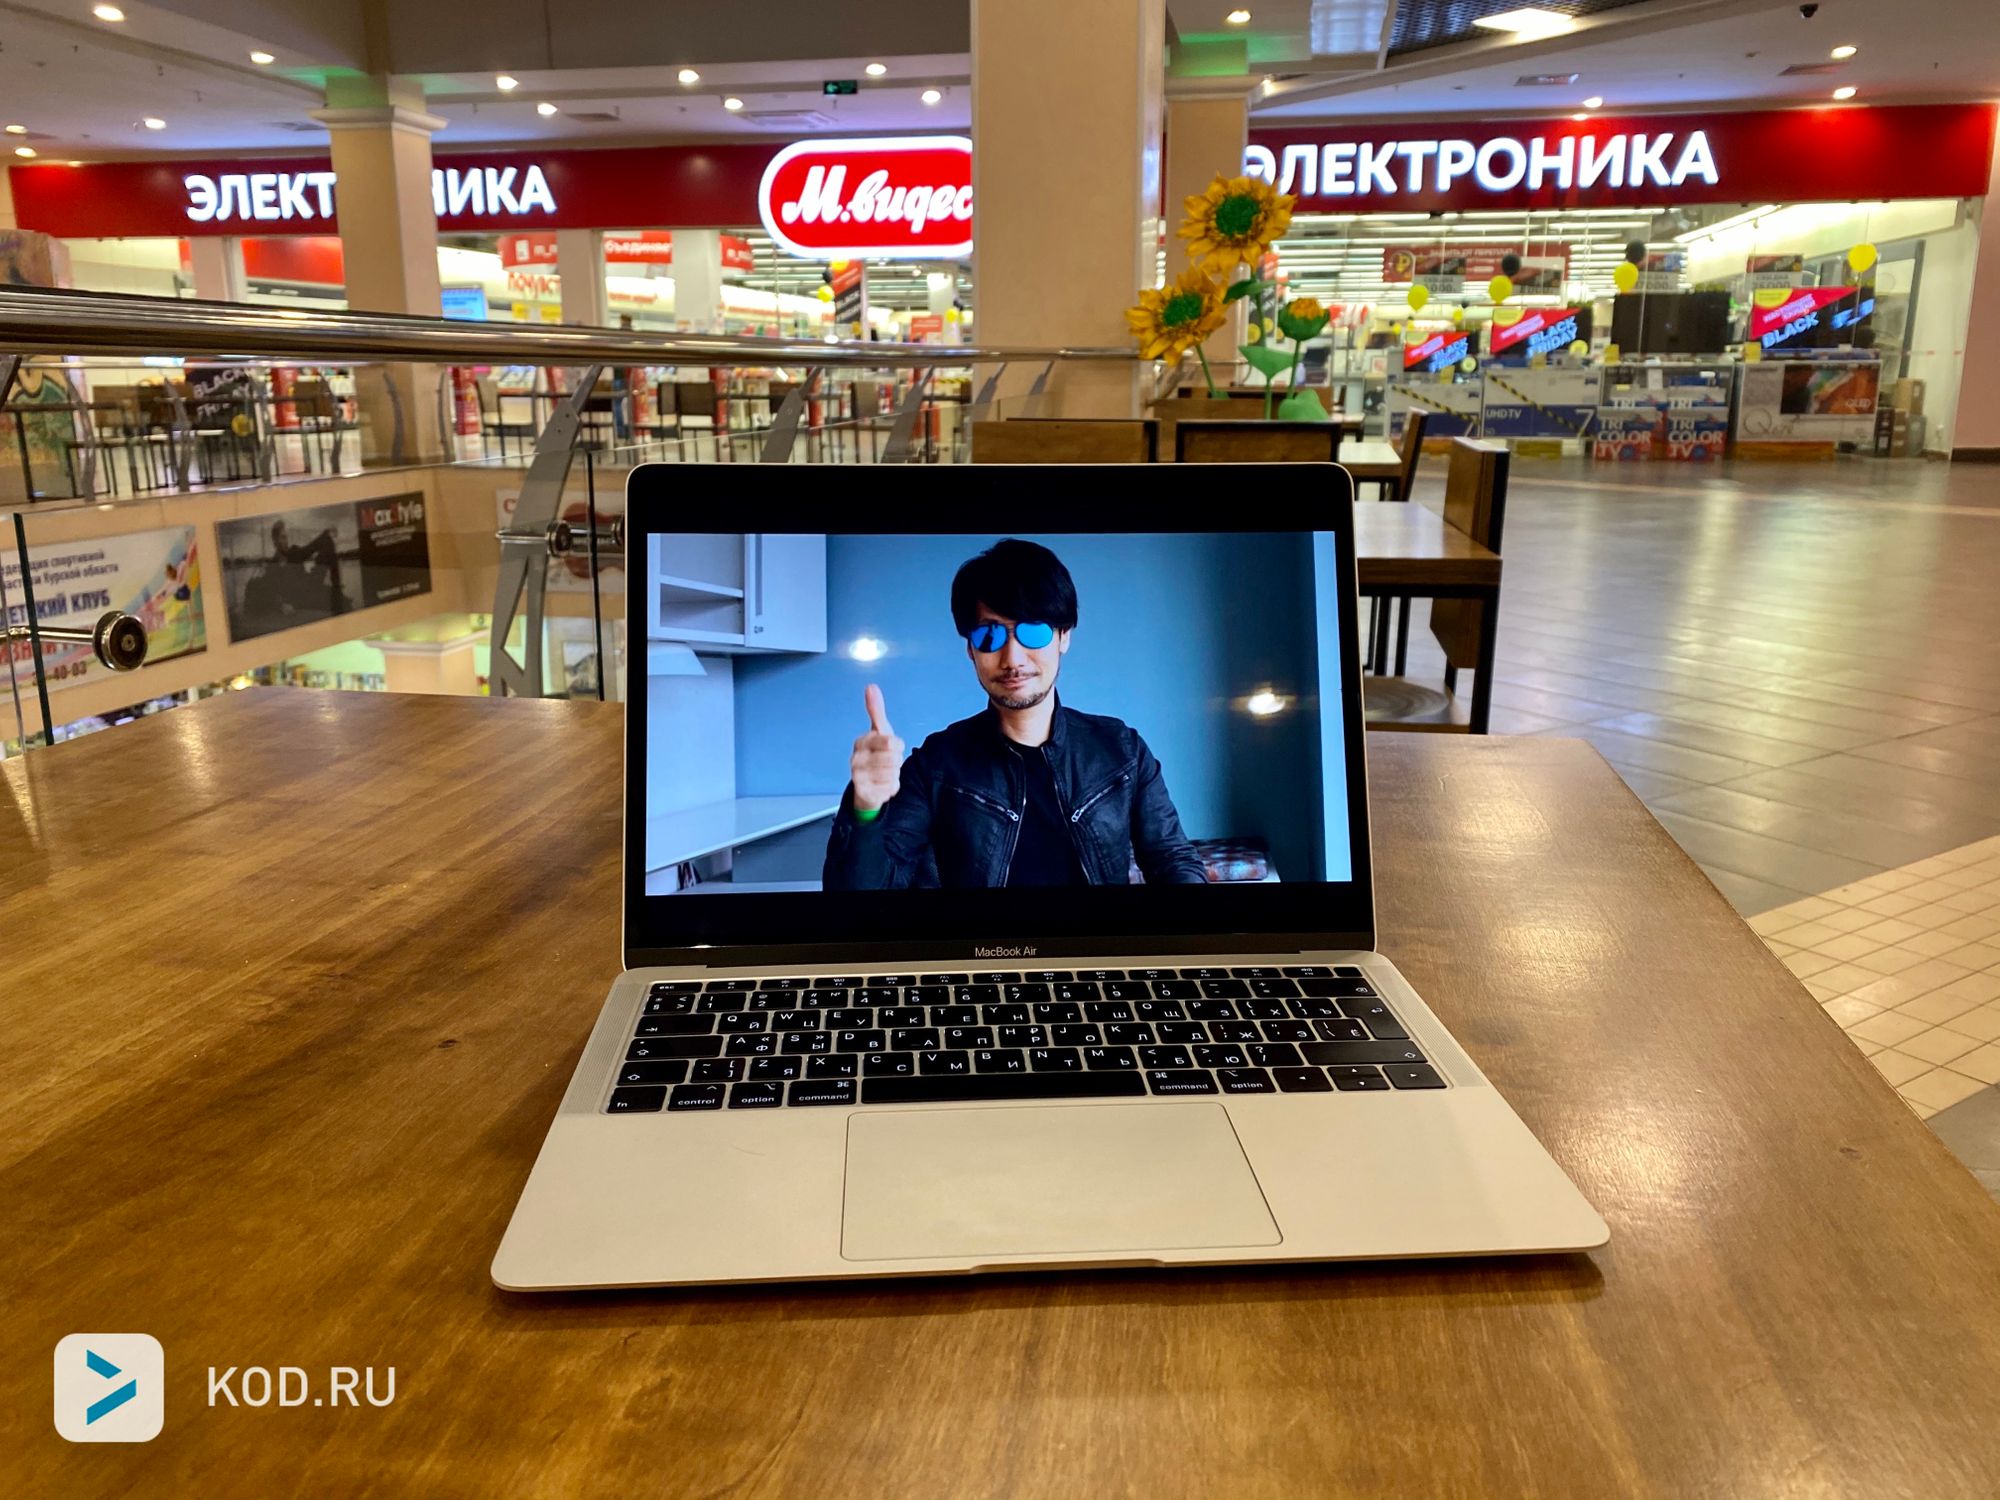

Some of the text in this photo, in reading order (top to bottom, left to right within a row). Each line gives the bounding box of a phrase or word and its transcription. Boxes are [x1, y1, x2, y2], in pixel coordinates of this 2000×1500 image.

[1243, 130, 1719, 196] ЭЛЕКТРОНИКА
[1762, 312, 1819, 348] BLACK
[1599, 430, 1652, 443] COLOR
[1668, 430, 1722, 443] COLOR
[71, 590, 110, 612] КЛУБ
[974, 945, 1037, 957] MacBook Air
[1230, 1082, 1264, 1090] option
[677, 1098, 716, 1106] control
[740, 1096, 775, 1105] option
[798, 1093, 850, 1101] command
